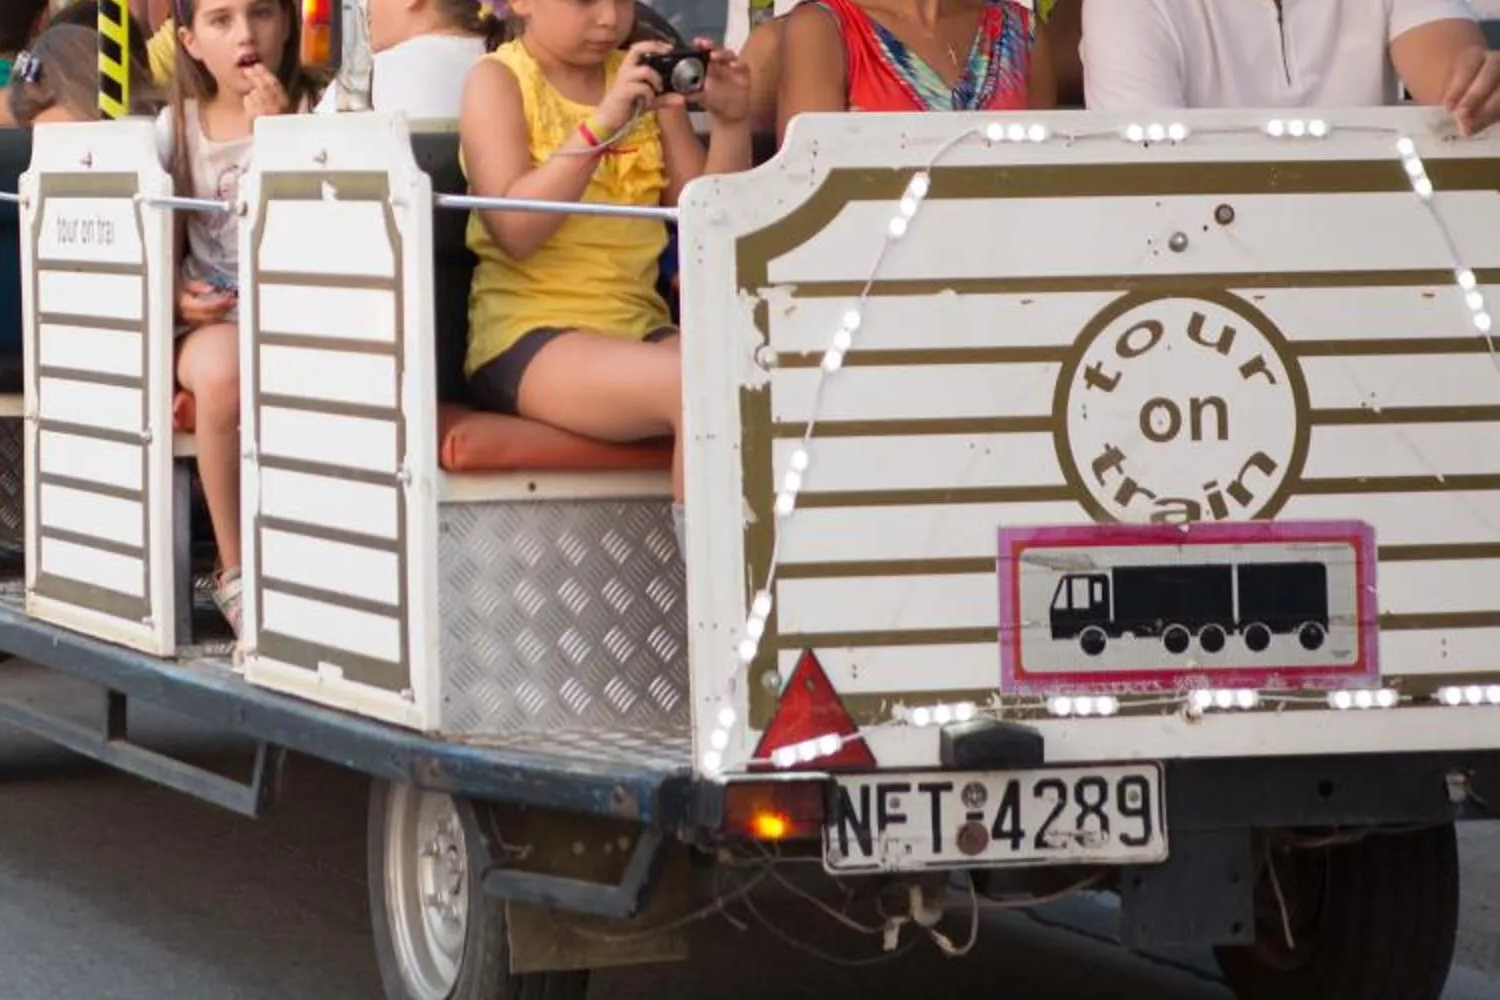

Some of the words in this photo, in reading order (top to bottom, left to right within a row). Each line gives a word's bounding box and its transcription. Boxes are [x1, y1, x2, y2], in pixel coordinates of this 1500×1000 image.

[1083, 311, 1277, 393] tour
[1139, 395, 1229, 443] on
[1091, 442, 1279, 524] train
